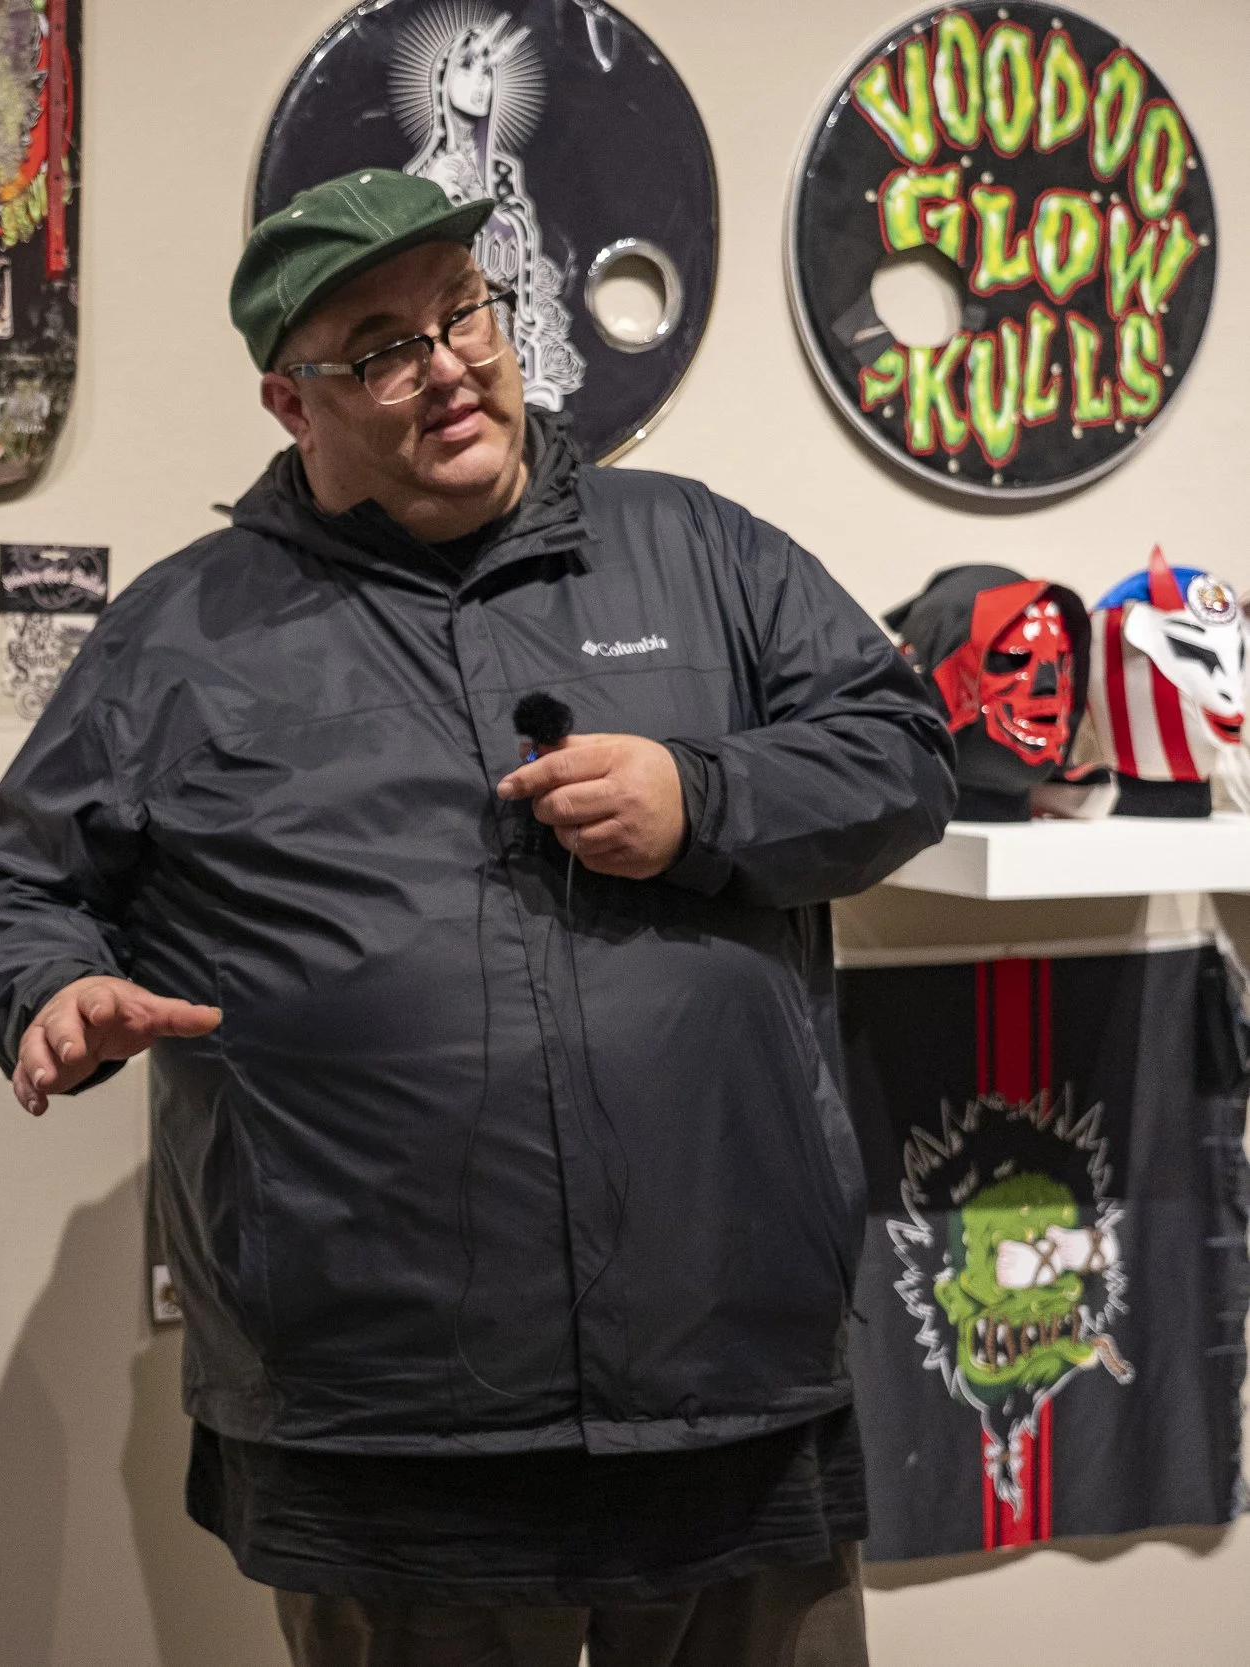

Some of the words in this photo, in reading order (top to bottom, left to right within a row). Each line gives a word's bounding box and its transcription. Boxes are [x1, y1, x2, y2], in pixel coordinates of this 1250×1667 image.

[850, 8, 1191, 221] VOODOO
[879, 165, 1199, 317] GLOW
[598, 634, 669, 657] Columbia
